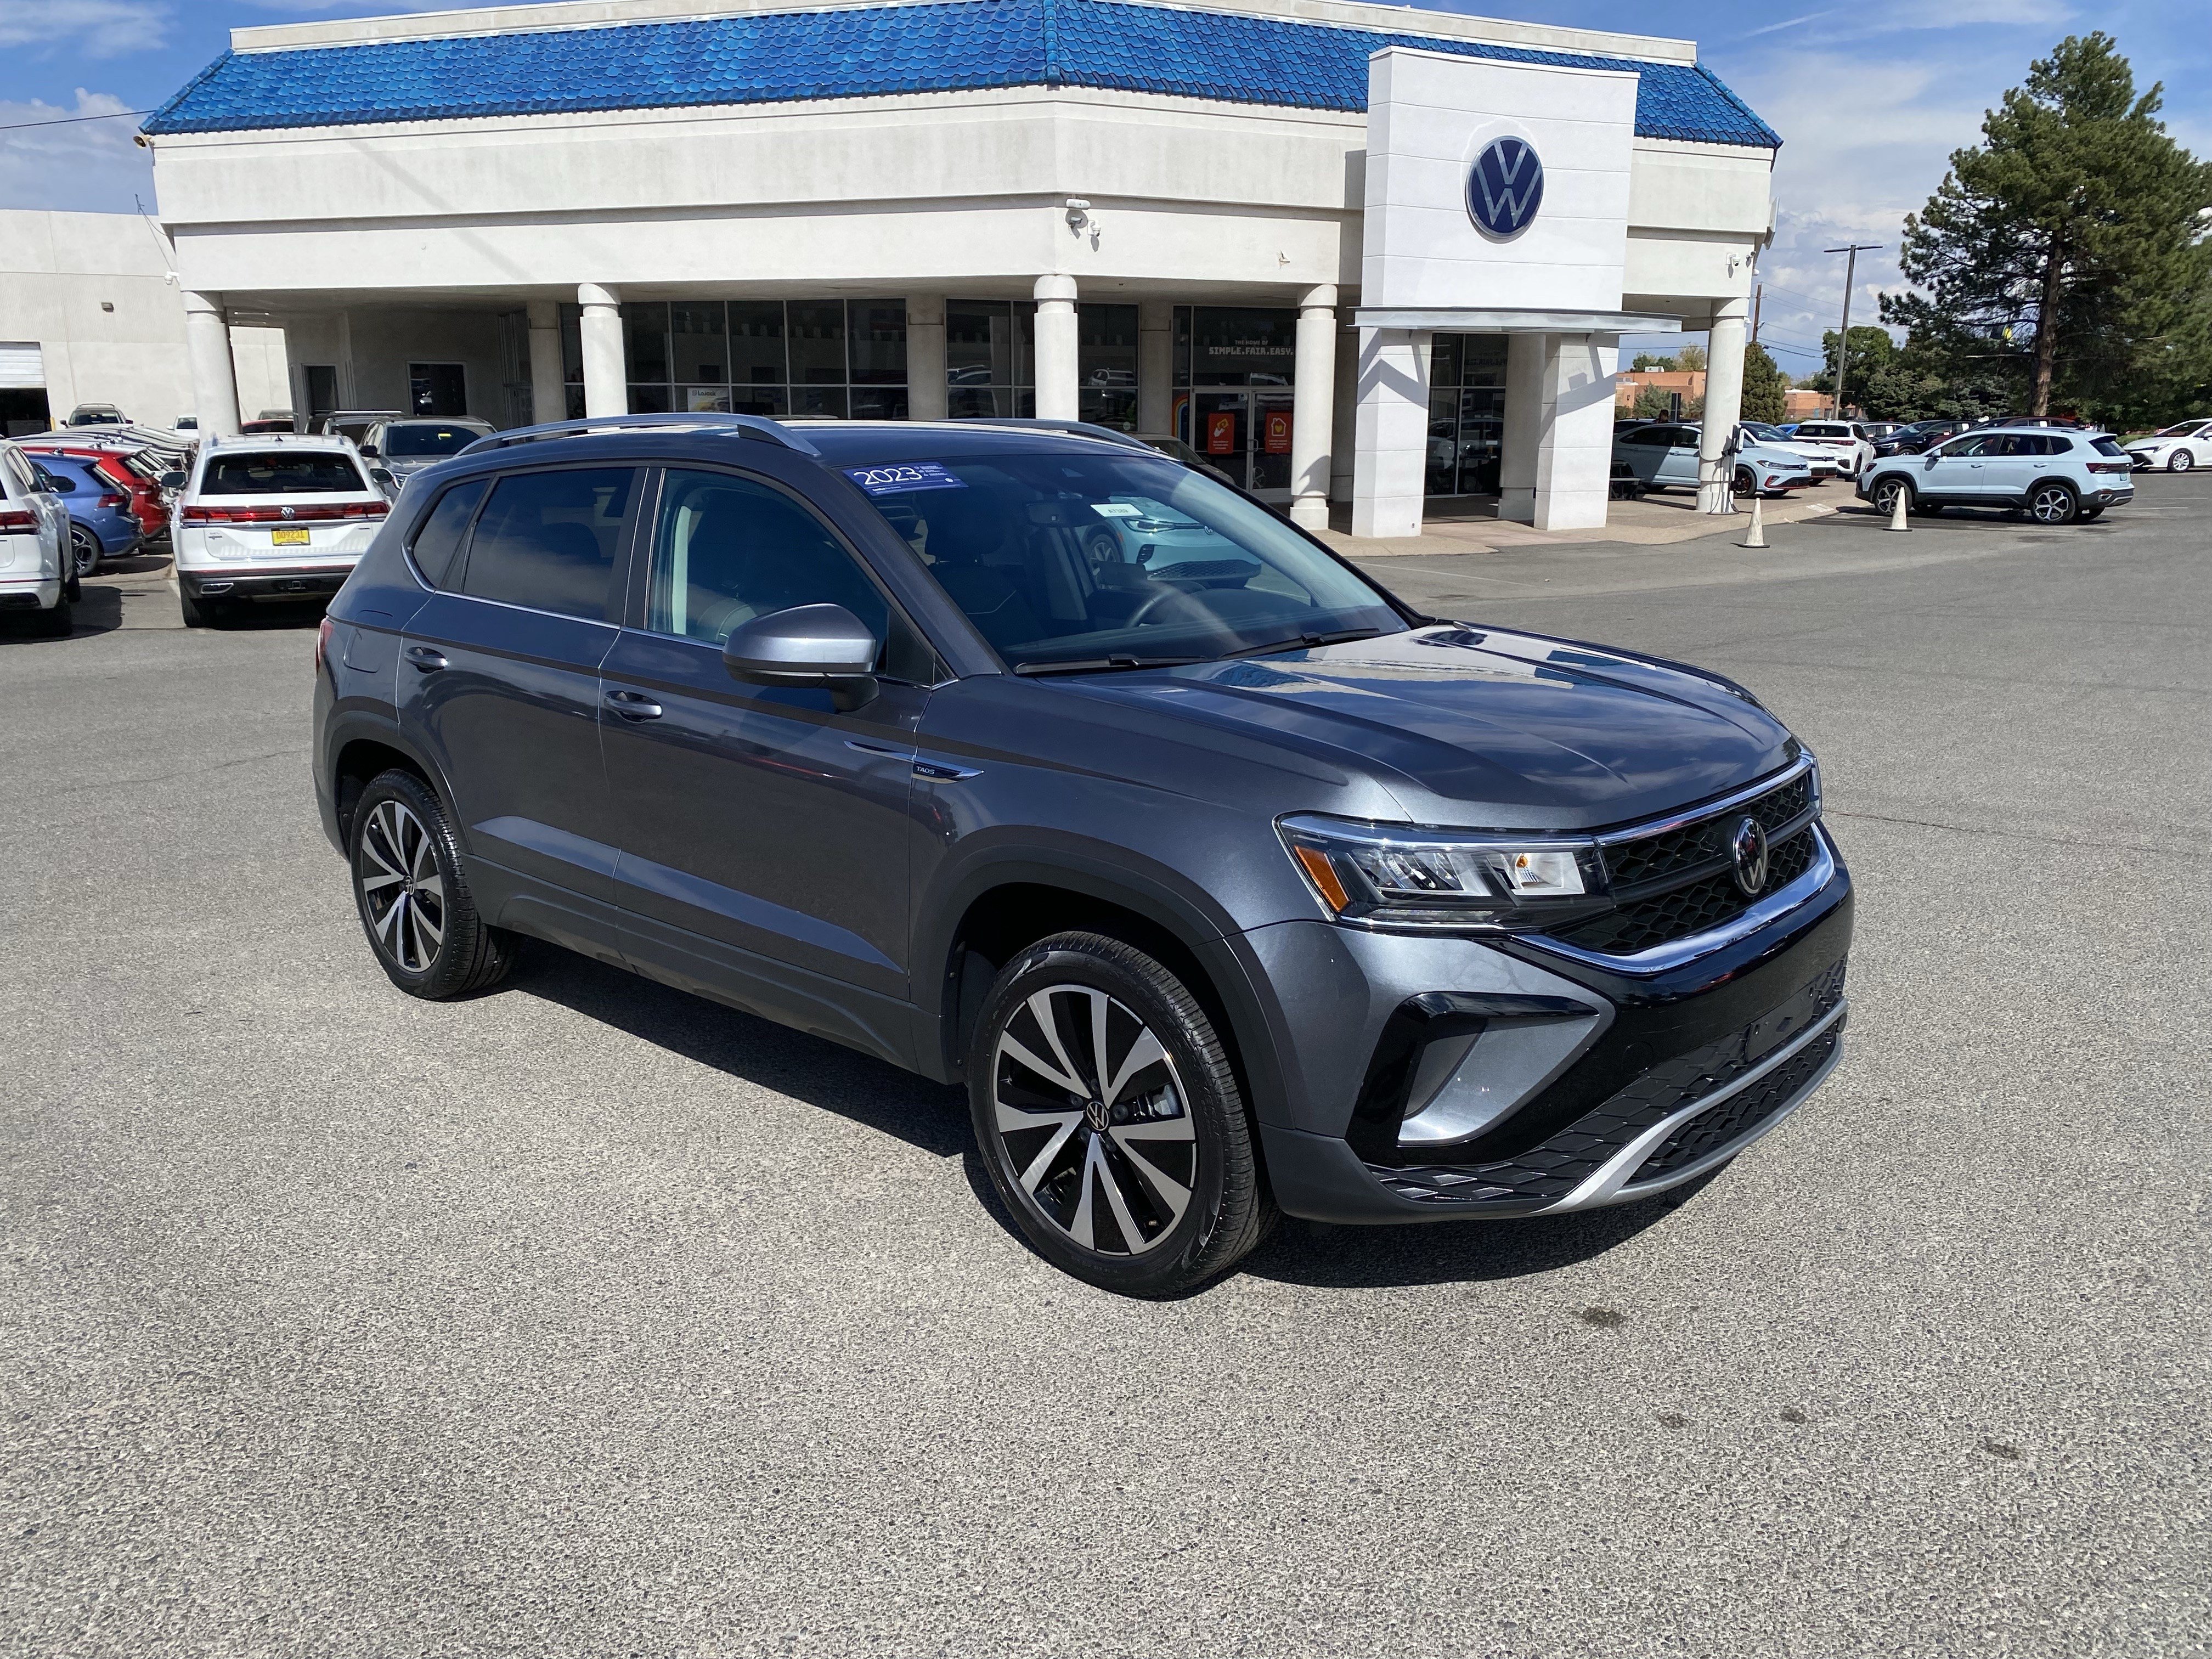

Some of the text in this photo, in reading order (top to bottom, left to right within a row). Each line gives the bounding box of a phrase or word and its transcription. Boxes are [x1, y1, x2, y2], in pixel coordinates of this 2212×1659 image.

[1474, 139, 1543, 228] VW
[854, 467, 922, 484] 2023
[916, 766, 935, 775] TAOS
[1087, 1102, 1107, 1130] VW
